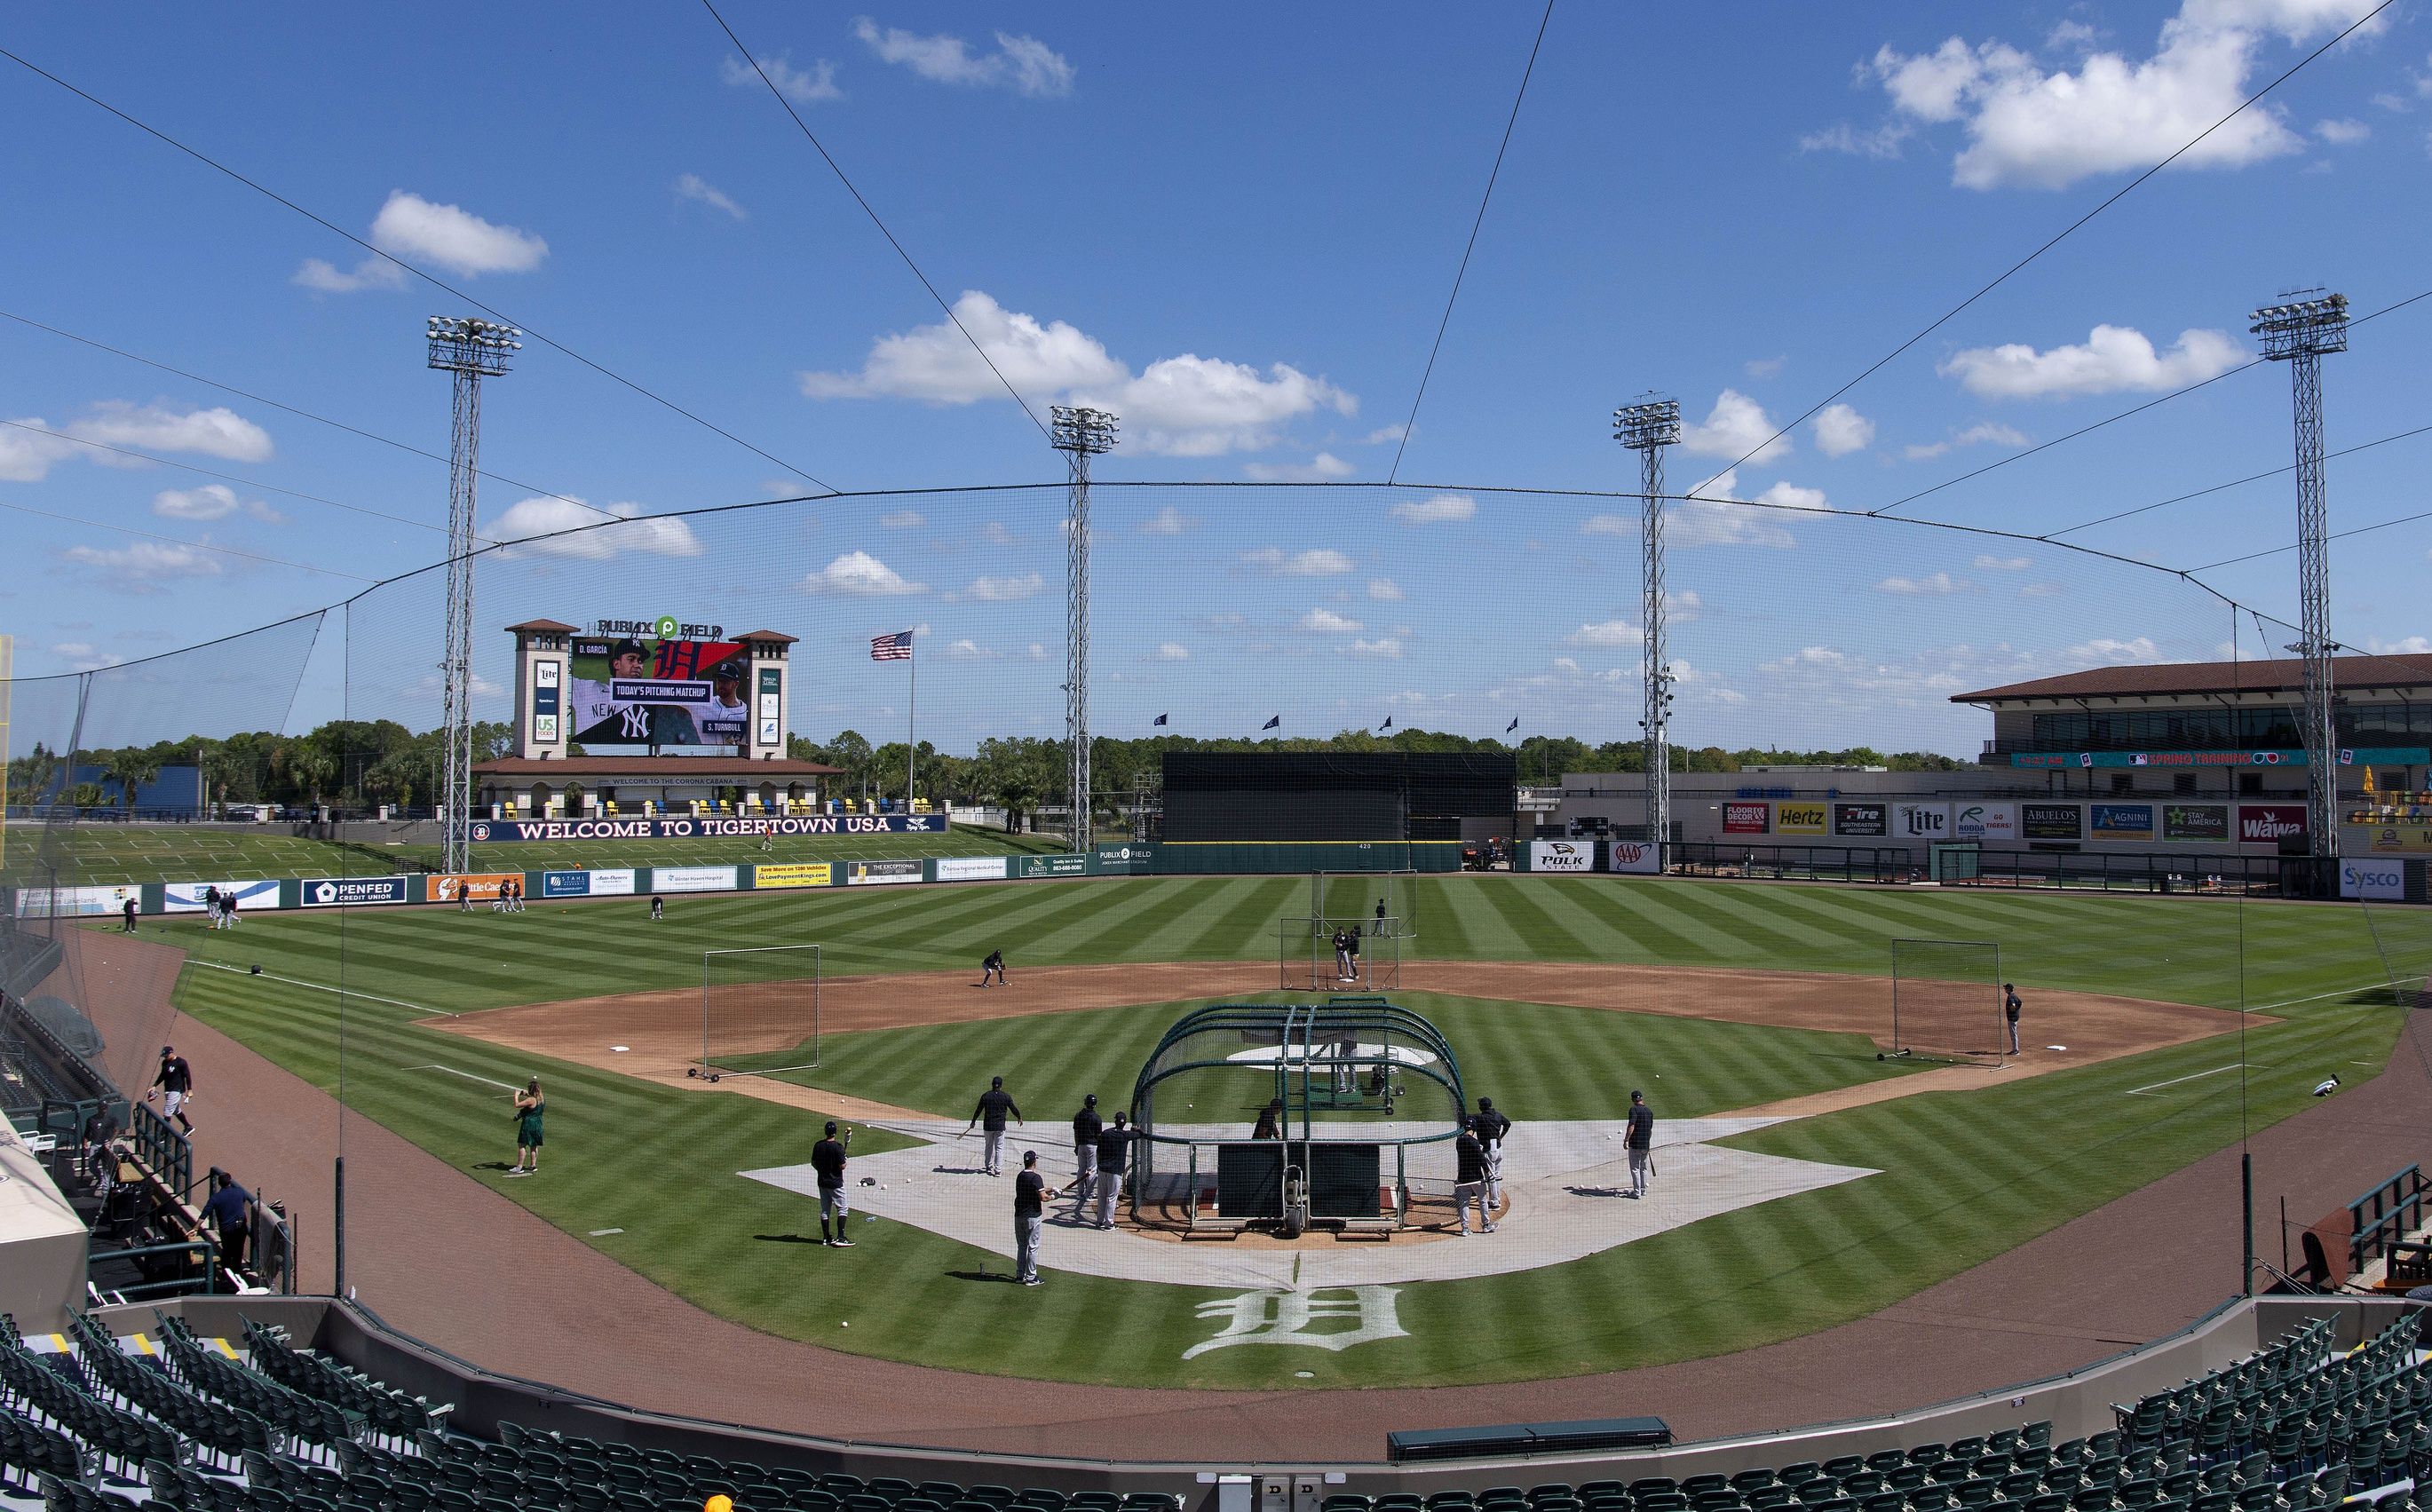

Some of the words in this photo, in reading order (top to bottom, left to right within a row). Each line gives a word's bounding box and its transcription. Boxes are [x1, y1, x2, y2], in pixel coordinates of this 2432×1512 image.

[598, 620, 653, 634] PUBLIX
[680, 624, 724, 637] FIELD
[586, 644, 608, 654] GARCÍA
[542, 670, 557, 680] Lite
[616, 685, 645, 696] TODAY'S
[645, 686, 675, 697] PITCHING
[676, 687, 706, 698] MATCHUP
[591, 703, 616, 718] NEW
[714, 723, 741, 732] TURNBULL
[2149, 754, 2192, 764] SPRING
[2194, 753, 2252, 764] TRAINING
[1780, 805, 1824, 825] Hertz
[1903, 806, 1944, 835] Lite
[2028, 810, 2077, 820] ABUELO'S
[2115, 812, 2147, 822] AGNINI
[517, 822, 652, 839] WELCOME
[661, 820, 693, 836] TO
[701, 818, 837, 835] TIGERTOWN
[846, 817, 891, 832] USA
[2244, 818, 2301, 838] Wawa
[1618, 843, 1639, 862] AAA
[1541, 856, 1584, 865] POLK
[2344, 867, 2400, 889] Sysco
[339, 883, 392, 894] PENFED
[467, 882, 484, 892] ittle
[485, 882, 515, 892] Caers
